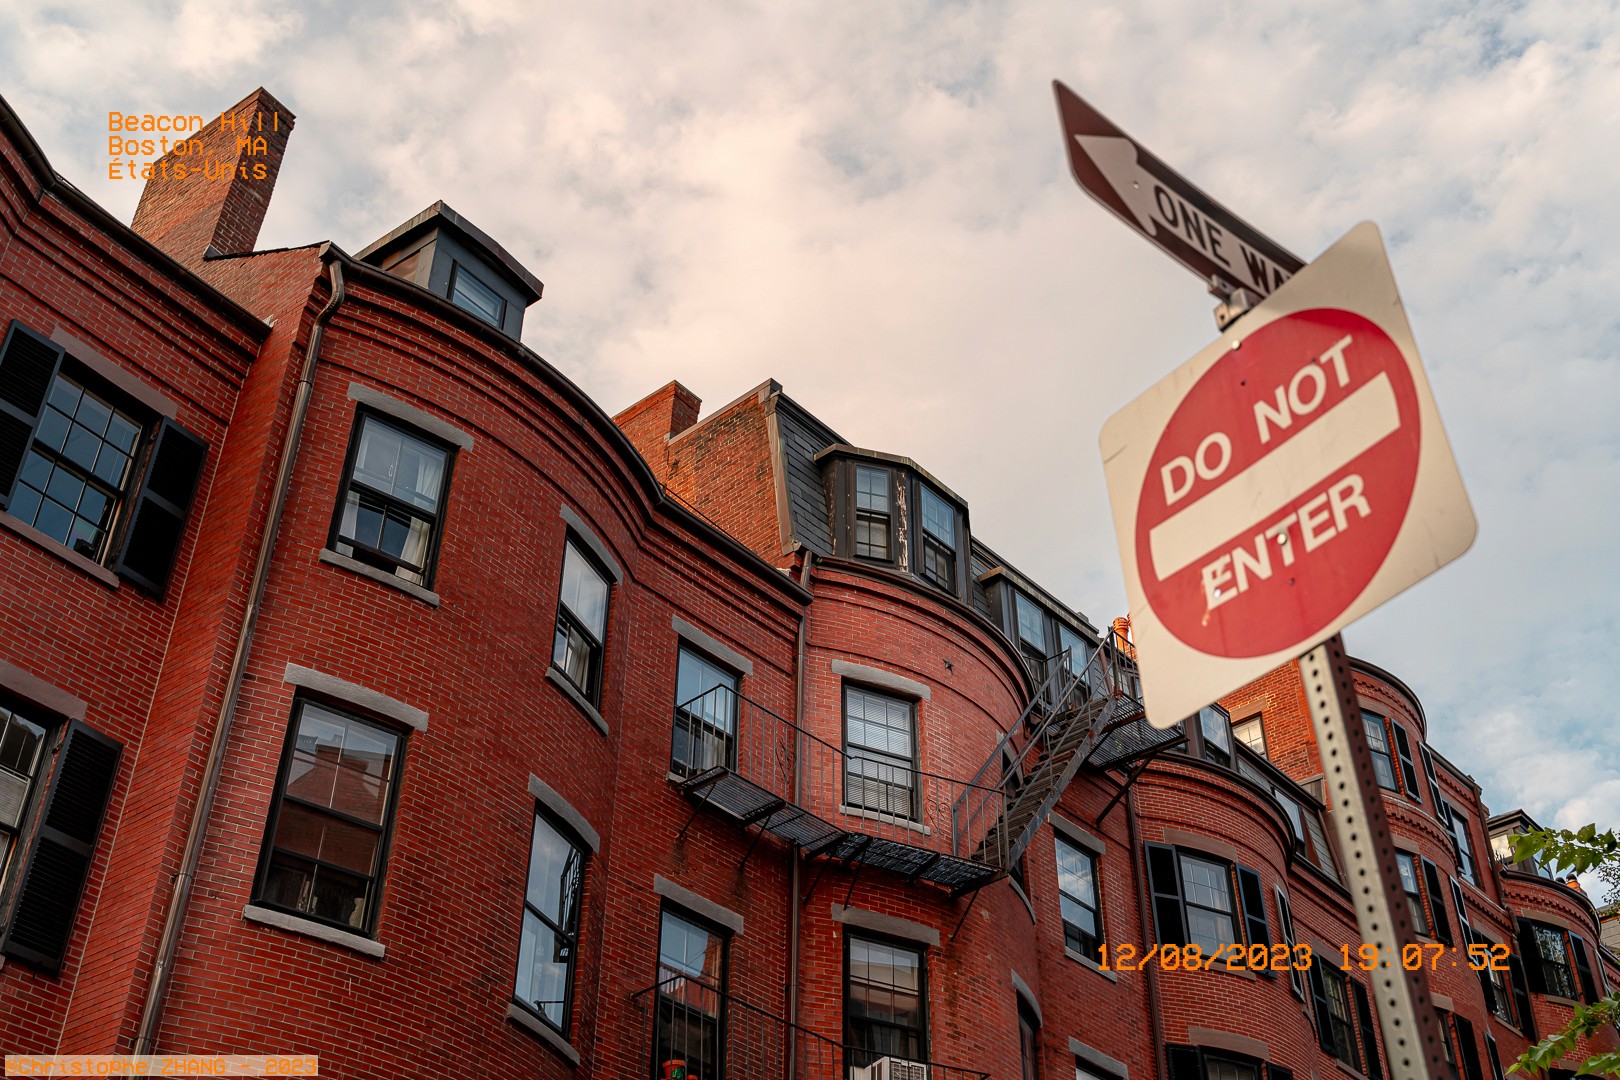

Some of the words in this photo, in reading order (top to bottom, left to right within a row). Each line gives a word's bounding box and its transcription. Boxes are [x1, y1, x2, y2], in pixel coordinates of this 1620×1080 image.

[1154, 185, 1230, 268] ONE
[1239, 244, 1290, 295] WA
[1160, 432, 1232, 506] DO
[1253, 334, 1353, 445] NOT
[1201, 473, 1372, 611] ENTER
